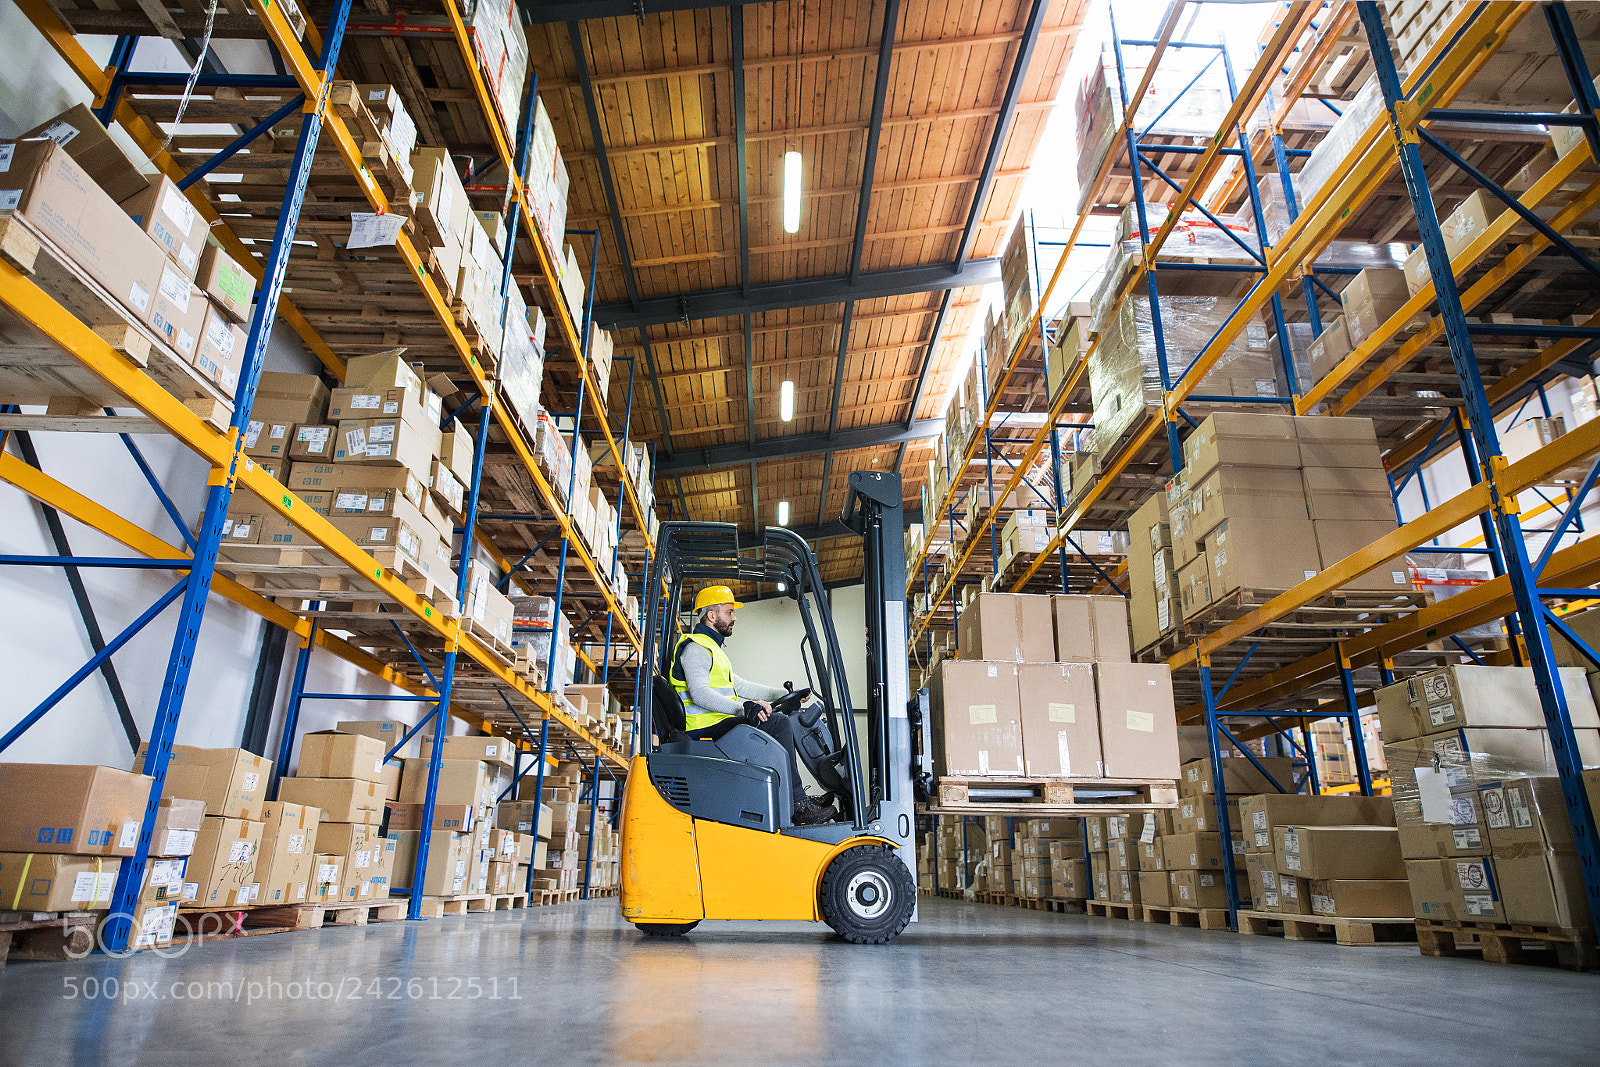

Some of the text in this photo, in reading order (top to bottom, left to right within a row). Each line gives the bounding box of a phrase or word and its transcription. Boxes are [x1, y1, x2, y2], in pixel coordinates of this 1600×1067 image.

[386, 389, 397, 401] E
[875, 472, 882, 481] 3
[249, 514, 259, 524] F
